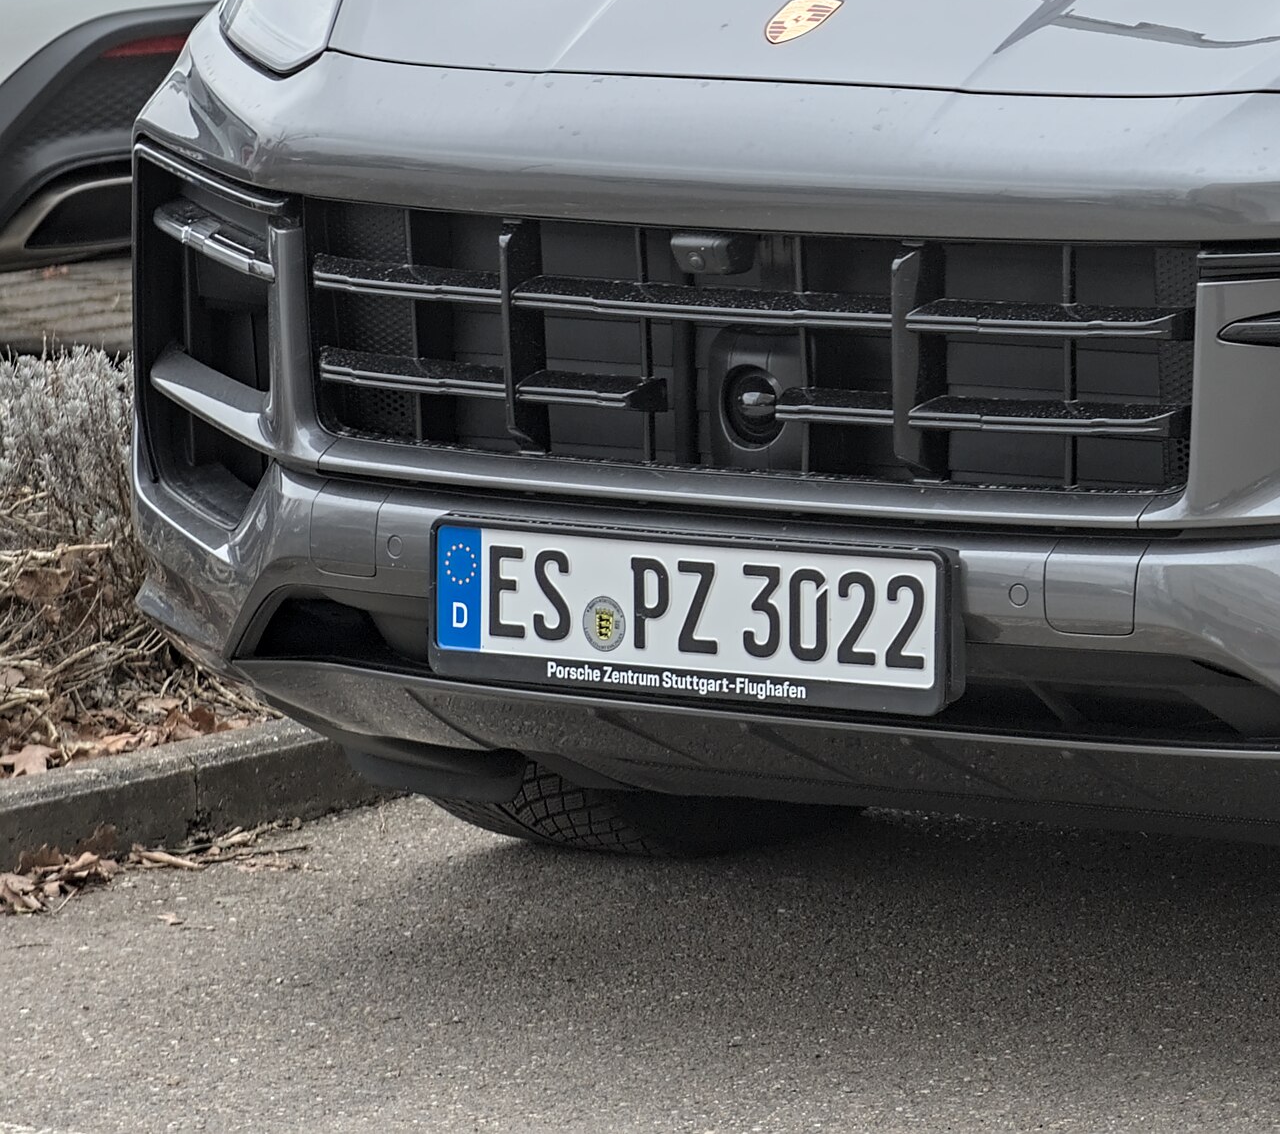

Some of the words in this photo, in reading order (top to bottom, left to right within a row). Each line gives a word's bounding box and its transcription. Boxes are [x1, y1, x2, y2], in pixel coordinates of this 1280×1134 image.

[451, 601, 469, 629] D
[488, 544, 571, 642] ES
[630, 556, 719, 655] PZ
[742, 563, 927, 670] 3022
[546, 662, 601, 683] Porsche
[602, 665, 660, 688] Zentrum
[662, 671, 807, 700] Stuttgart-Flughafen
